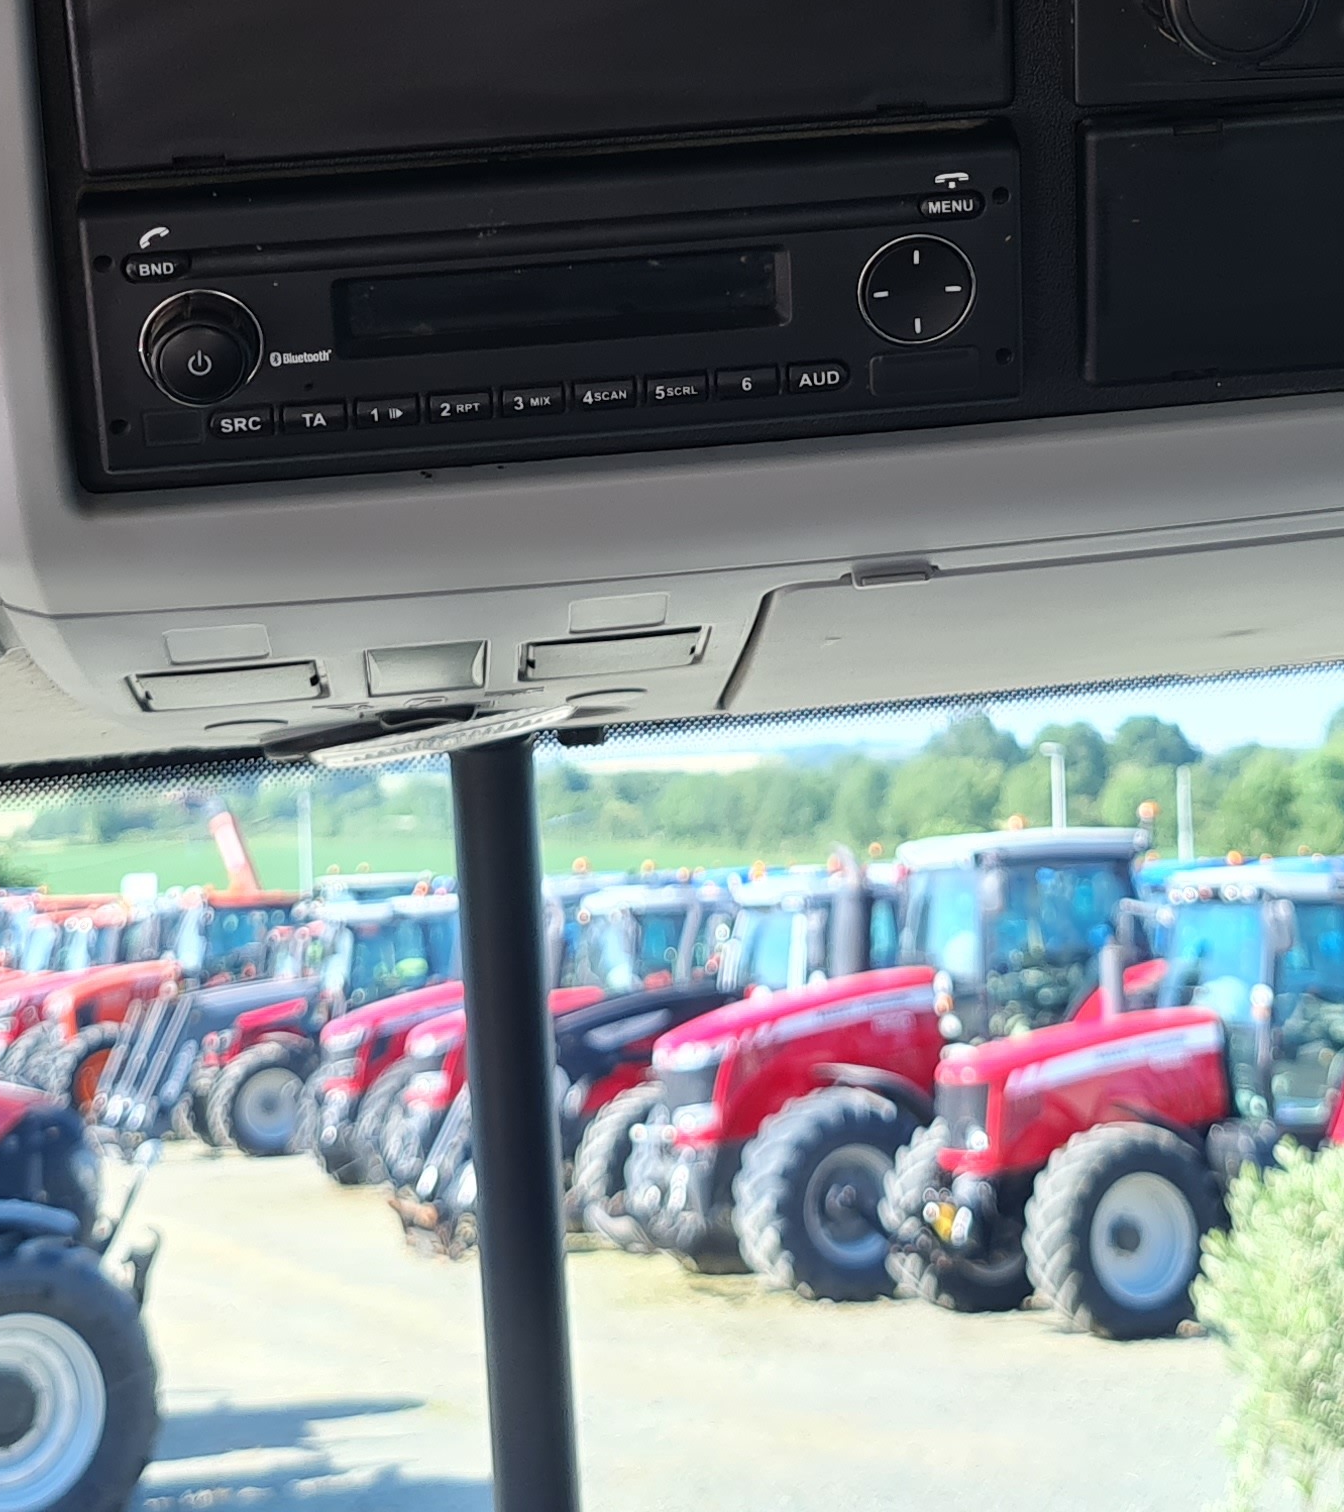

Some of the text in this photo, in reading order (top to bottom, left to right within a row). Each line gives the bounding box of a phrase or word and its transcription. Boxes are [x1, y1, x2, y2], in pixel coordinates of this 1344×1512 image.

[926, 198, 975, 215] MENU
[137, 261, 175, 278] BND
[281, 349, 333, 365] Bluetooth
[740, 376, 753, 392] 6
[798, 369, 841, 389] AUD
[439, 400, 481, 418] 2 RPT
[512, 395, 552, 412] 3 MIX
[300, 411, 328, 428] TA
[369, 406, 380, 423] 1
[219, 415, 263, 434] SRC
